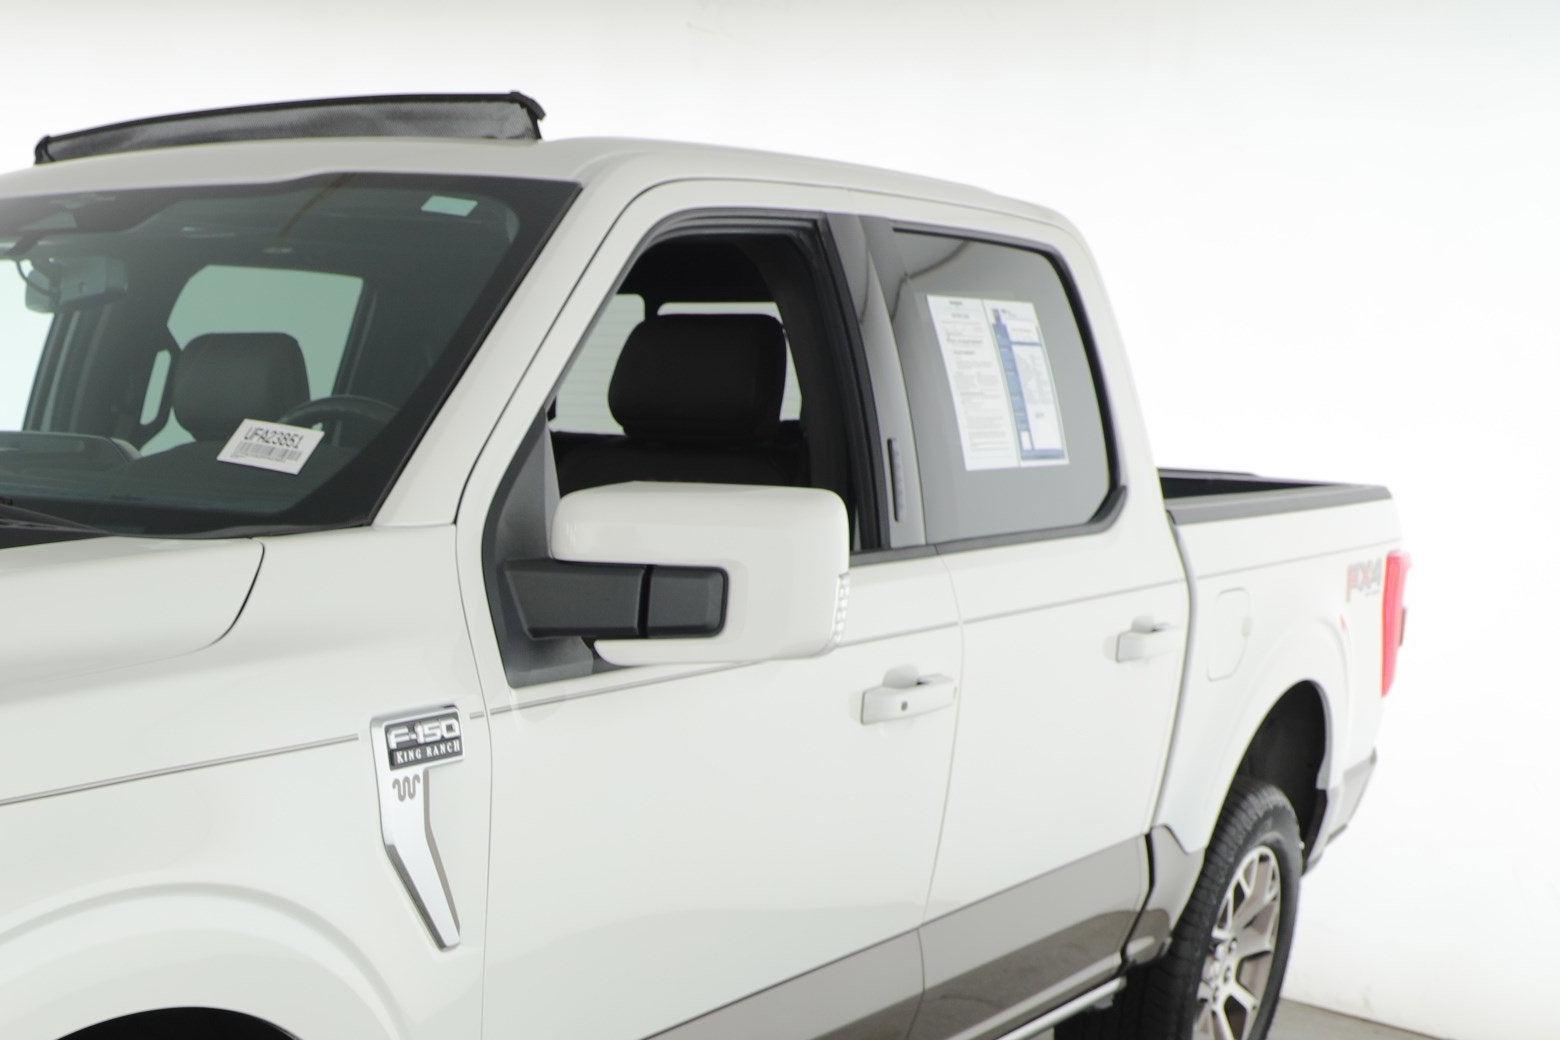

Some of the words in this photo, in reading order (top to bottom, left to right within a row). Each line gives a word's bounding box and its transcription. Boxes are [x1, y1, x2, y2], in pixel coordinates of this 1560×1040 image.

[387, 718, 461, 750] F-150
[396, 749, 422, 765] KING
[426, 740, 461, 758] RANCH
